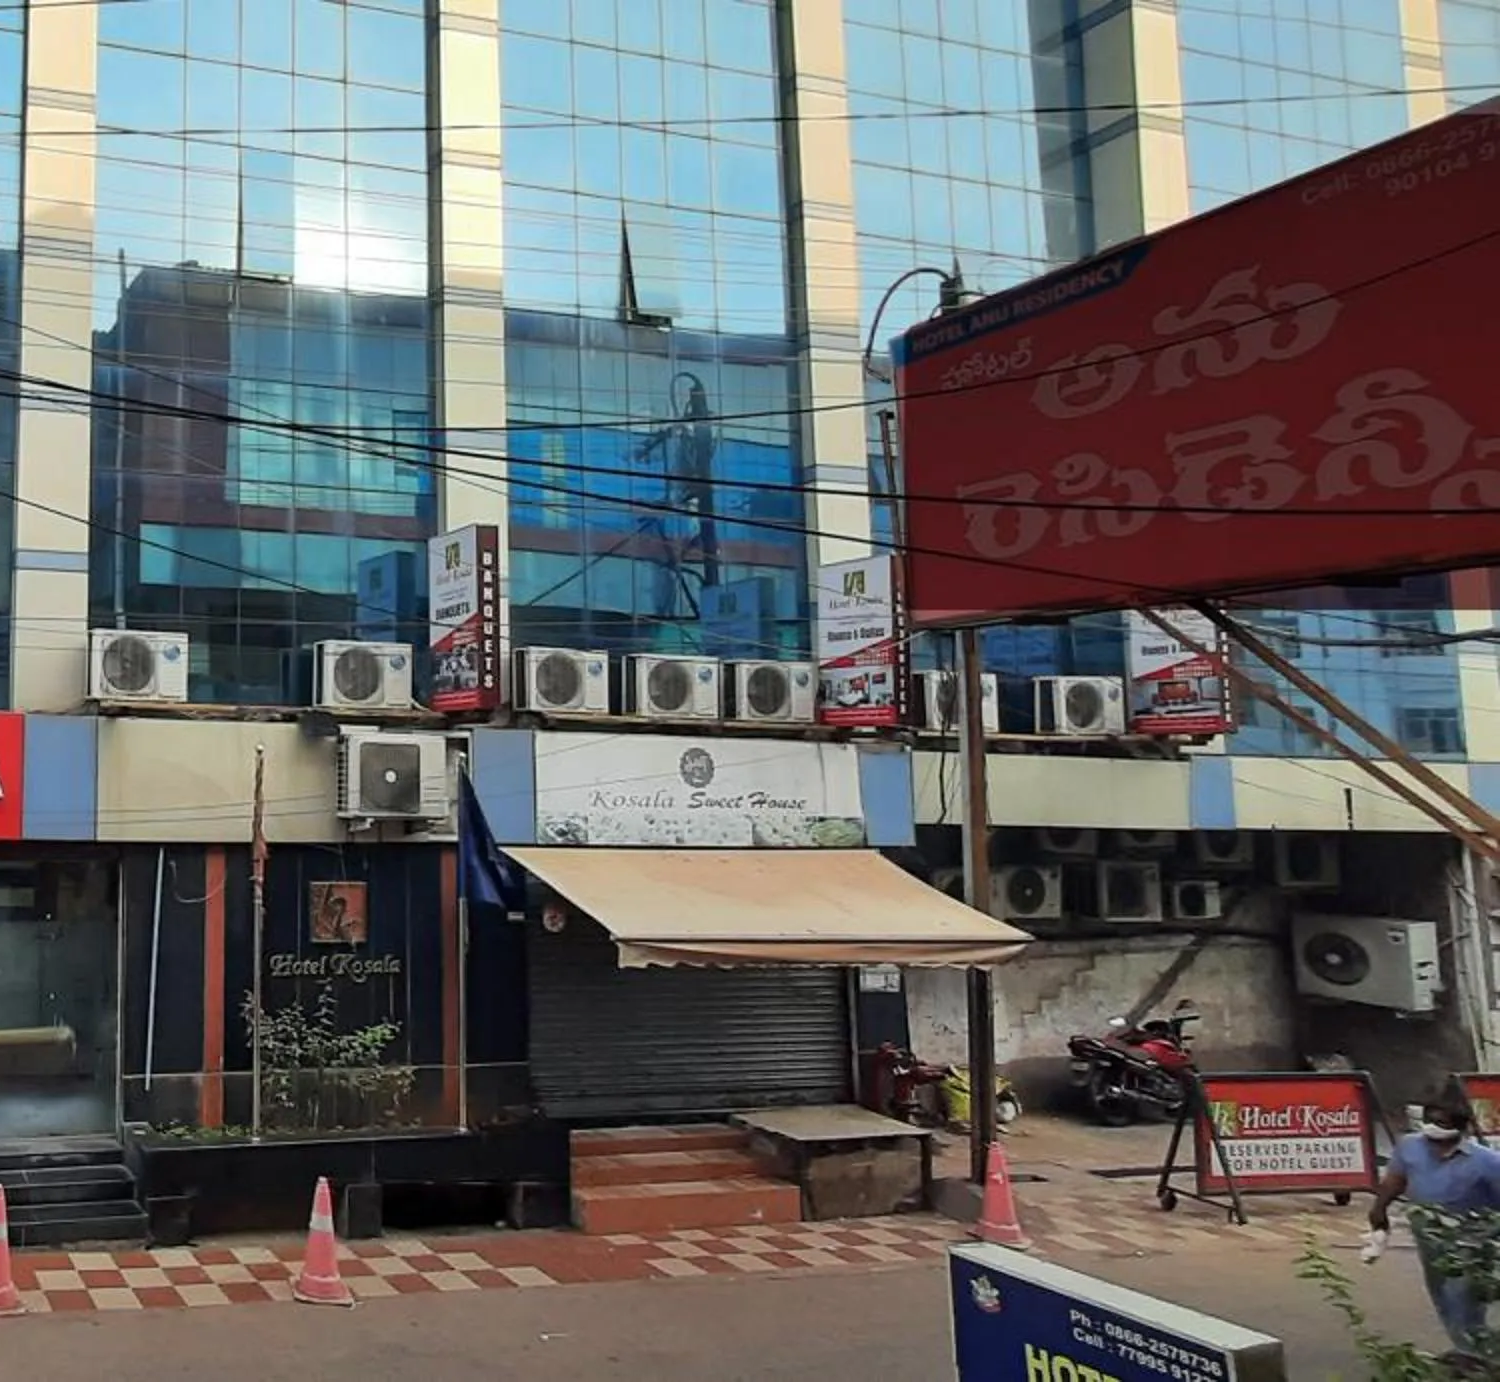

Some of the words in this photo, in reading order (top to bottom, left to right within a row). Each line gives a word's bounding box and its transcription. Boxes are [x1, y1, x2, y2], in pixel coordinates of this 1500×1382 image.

[1366, 117, 1500, 179] 0866-257
[912, 324, 964, 353] HOTEL
[970, 306, 1010, 333] ANU
[1013, 260, 1124, 316] RESIDENCY
[1030, 263, 1345, 420] అను
[482, 551, 494, 689] BANQUETS
[588, 789, 675, 809] Kosala
[687, 791, 744, 810] Sweet
[747, 790, 808, 810] House
[269, 952, 328, 977] Hotel
[329, 952, 401, 984] Kosala
[1238, 1104, 1291, 1130] Hotel
[1297, 1102, 1361, 1137] Kosala
[1259, 1156, 1304, 1171] HOTEL
[1309, 1155, 1353, 1170] GUEST
[1295, 1139, 1357, 1155] PARKING
[1069, 1308, 1093, 1329] Ph
[1073, 1325, 1104, 1350] Cell
